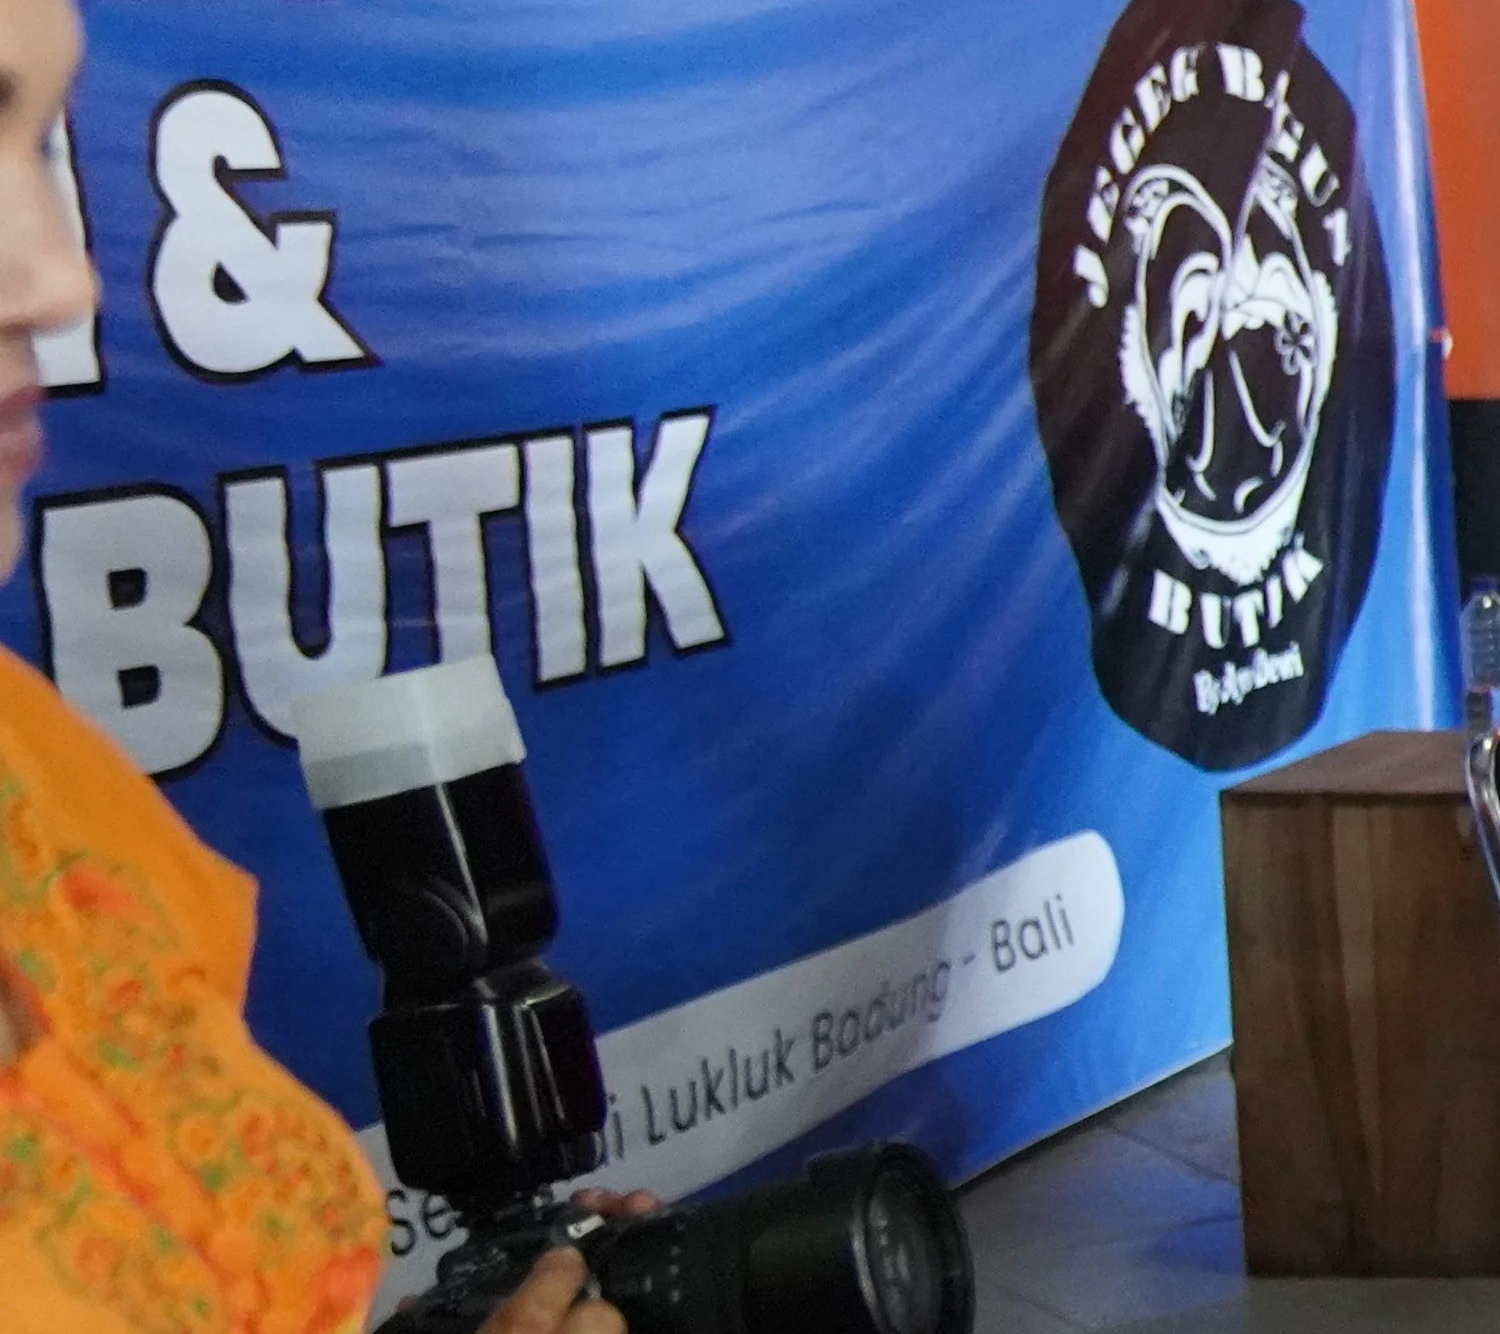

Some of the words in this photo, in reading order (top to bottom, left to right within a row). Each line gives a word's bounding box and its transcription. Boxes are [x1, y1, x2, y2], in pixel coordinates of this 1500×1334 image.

[36, 407, 728, 782] BUTIK
[1149, 532, 1324, 650] BUTIK
[640, 1028, 797, 1147] Lukluk
[809, 958, 953, 1076] Badung
[989, 893, 1075, 975] Bali
